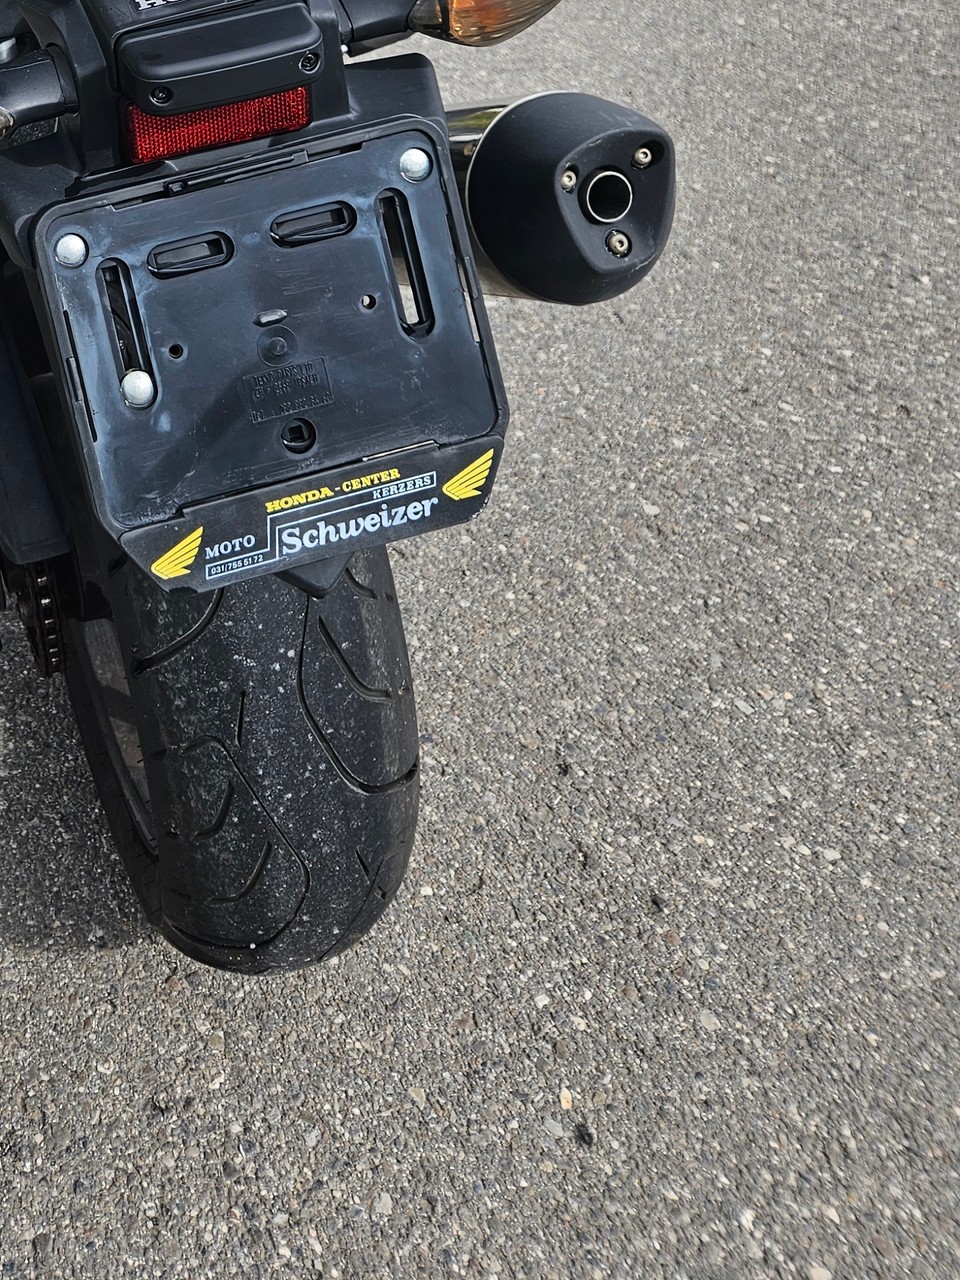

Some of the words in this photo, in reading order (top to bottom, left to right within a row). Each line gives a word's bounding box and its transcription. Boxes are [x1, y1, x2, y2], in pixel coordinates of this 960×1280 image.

[373, 475, 432, 500] KERZERS
[281, 497, 438, 555] Schweizer
[205, 534, 256, 560] MOTO
